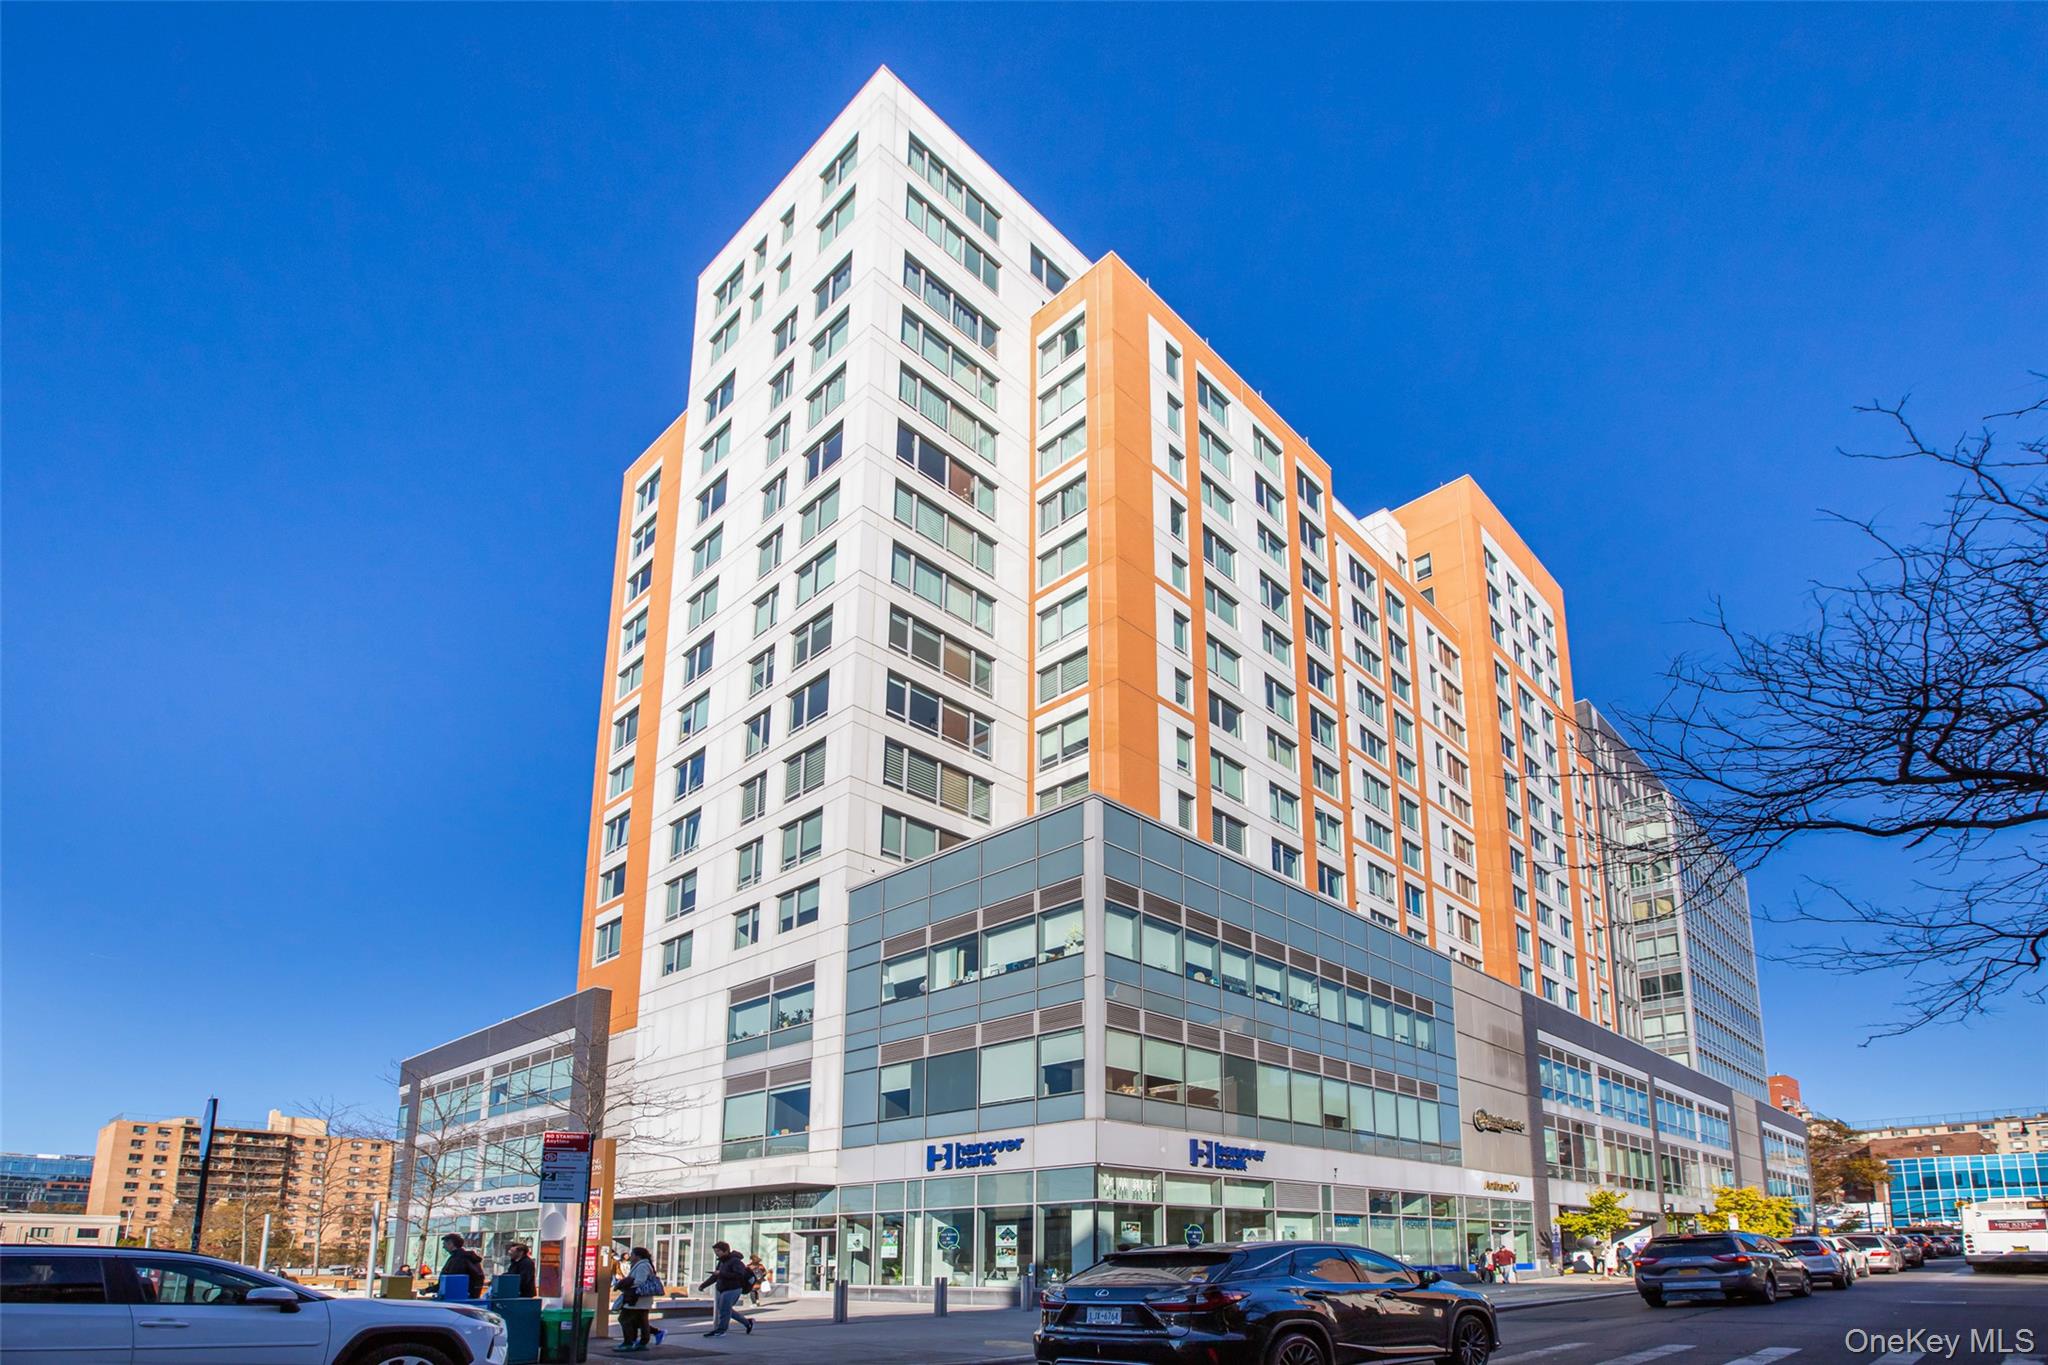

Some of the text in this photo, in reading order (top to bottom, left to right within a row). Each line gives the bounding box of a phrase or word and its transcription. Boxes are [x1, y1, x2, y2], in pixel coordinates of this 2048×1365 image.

[955, 1137, 1025, 1156] hanover
[955, 1153, 997, 1169] bank
[479, 1194, 511, 1206] SPACE
[512, 1187, 535, 1203] BBQ
